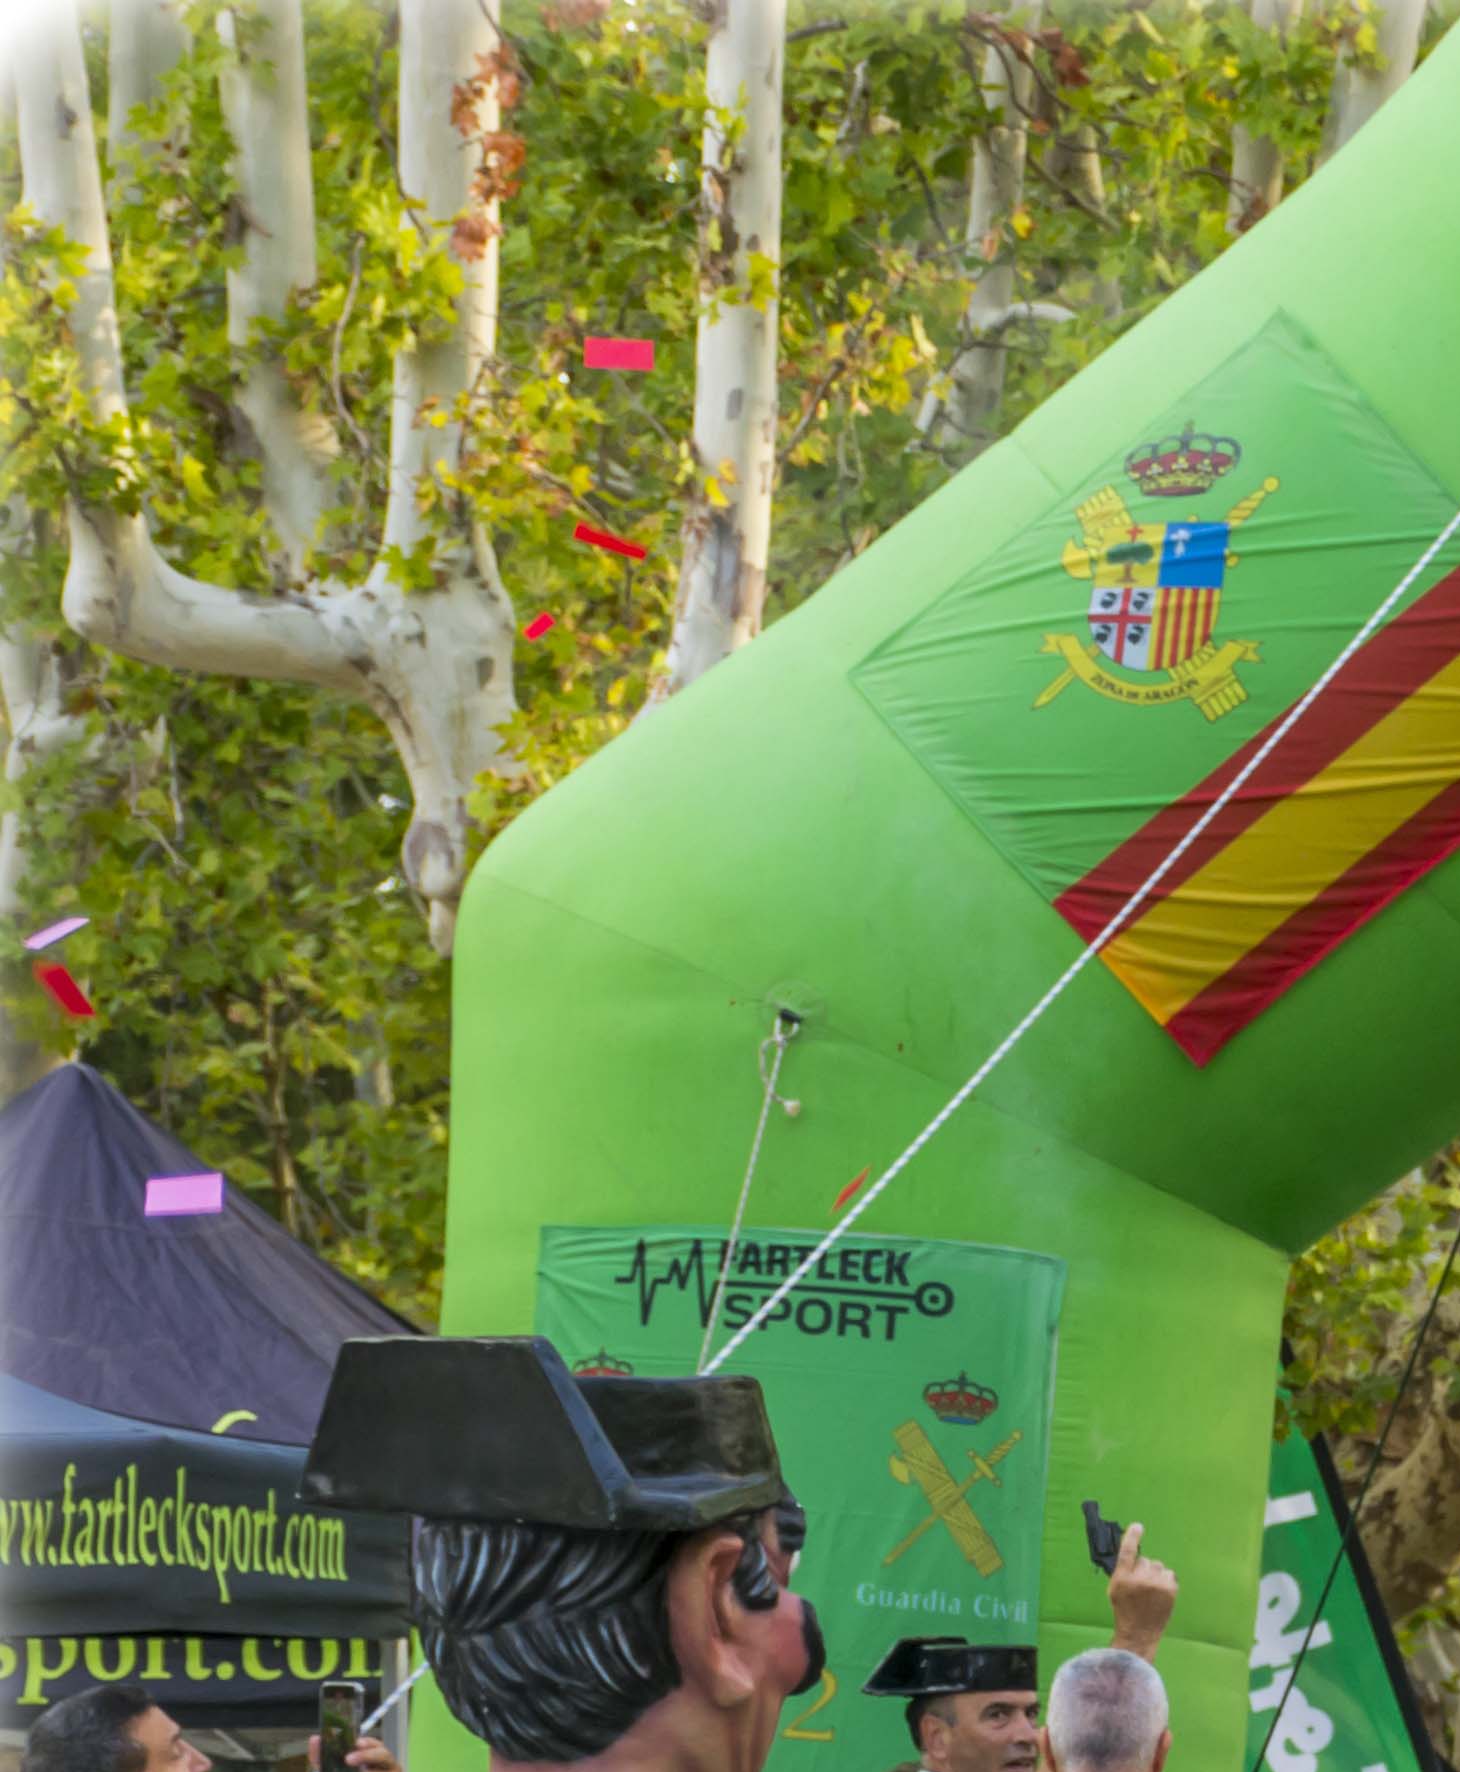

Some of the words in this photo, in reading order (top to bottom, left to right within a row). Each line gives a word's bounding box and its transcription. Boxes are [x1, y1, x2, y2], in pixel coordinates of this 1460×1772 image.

[722, 1293, 911, 1341] SPORT
[855, 1582, 963, 1618] Guardia
[973, 1593, 1030, 1624] Civil
